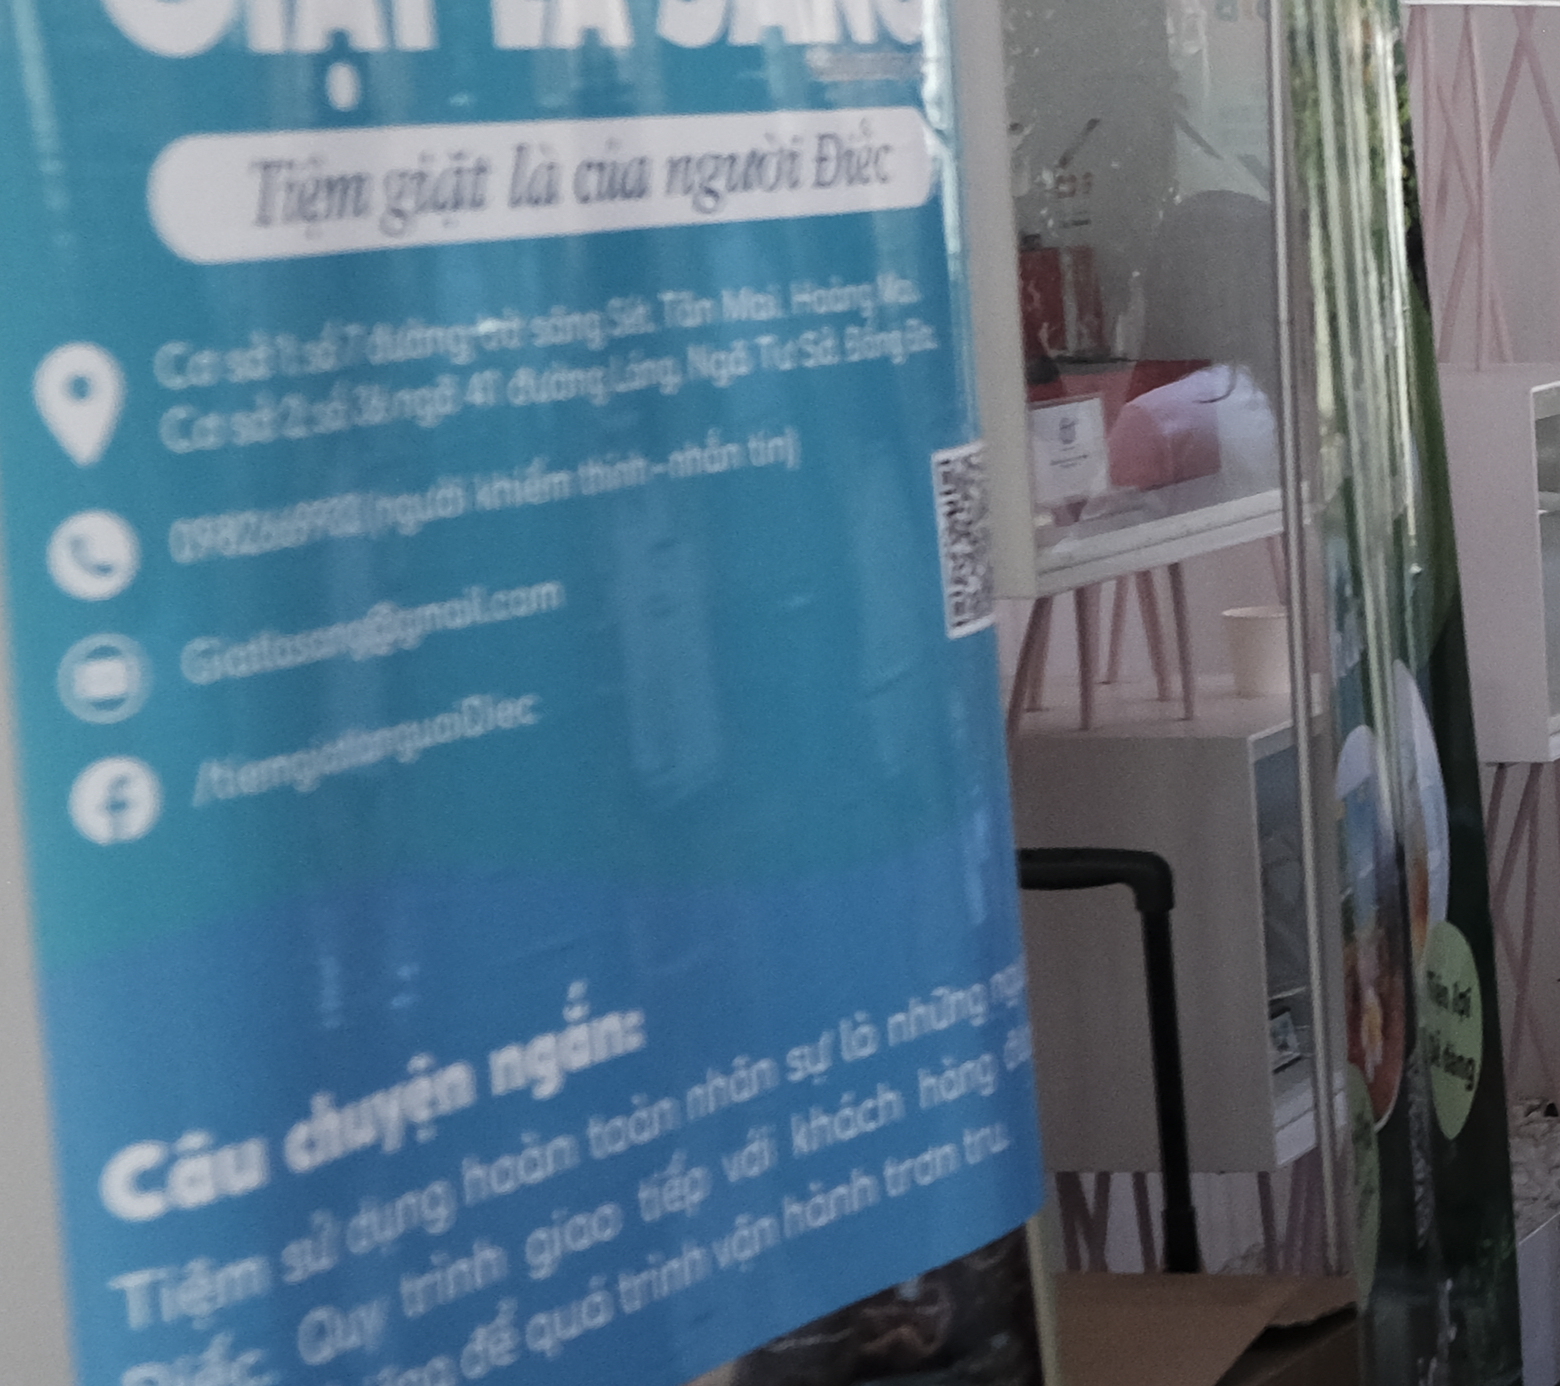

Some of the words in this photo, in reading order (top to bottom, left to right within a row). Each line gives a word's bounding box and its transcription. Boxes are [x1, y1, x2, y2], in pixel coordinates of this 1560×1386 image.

[251, 152, 366, 240] Tiệm
[379, 146, 491, 239] giặt
[508, 141, 559, 211] là
[572, 136, 647, 206] của
[666, 132, 800, 213] người
[813, 116, 893, 189] Điếc
[100, 1130, 270, 1222] Câu
[283, 1054, 476, 1174] chuyện
[488, 980, 647, 1100] ngắn:
[108, 1256, 270, 1331] Tiệm
[281, 1208, 342, 1285] sử
[346, 1179, 457, 1256] dụng
[462, 1130, 580, 1205] hoàn
[587, 1091, 681, 1160] toàn
[686, 1054, 779, 1121] nhân
[786, 1030, 835, 1085] sự
[839, 1010, 879, 1063] là
[887, 984, 989, 1047] những
[298, 1296, 390, 1366] Quy
[401, 1237, 509, 1318] trình
[525, 1201, 624, 1280] giao
[637, 1148, 713, 1224] tiếp
[722, 1124, 778, 1184] với
[790, 1081, 902, 1158] khách
[918, 1053, 1000, 1109] hàng
[460, 1296, 522, 1380] để
[525, 1274, 616, 1358] quá
[618, 1241, 709, 1315] trình
[712, 1213, 780, 1274] vận
[782, 1168, 881, 1239] hành
[883, 1142, 960, 1199] trơn
